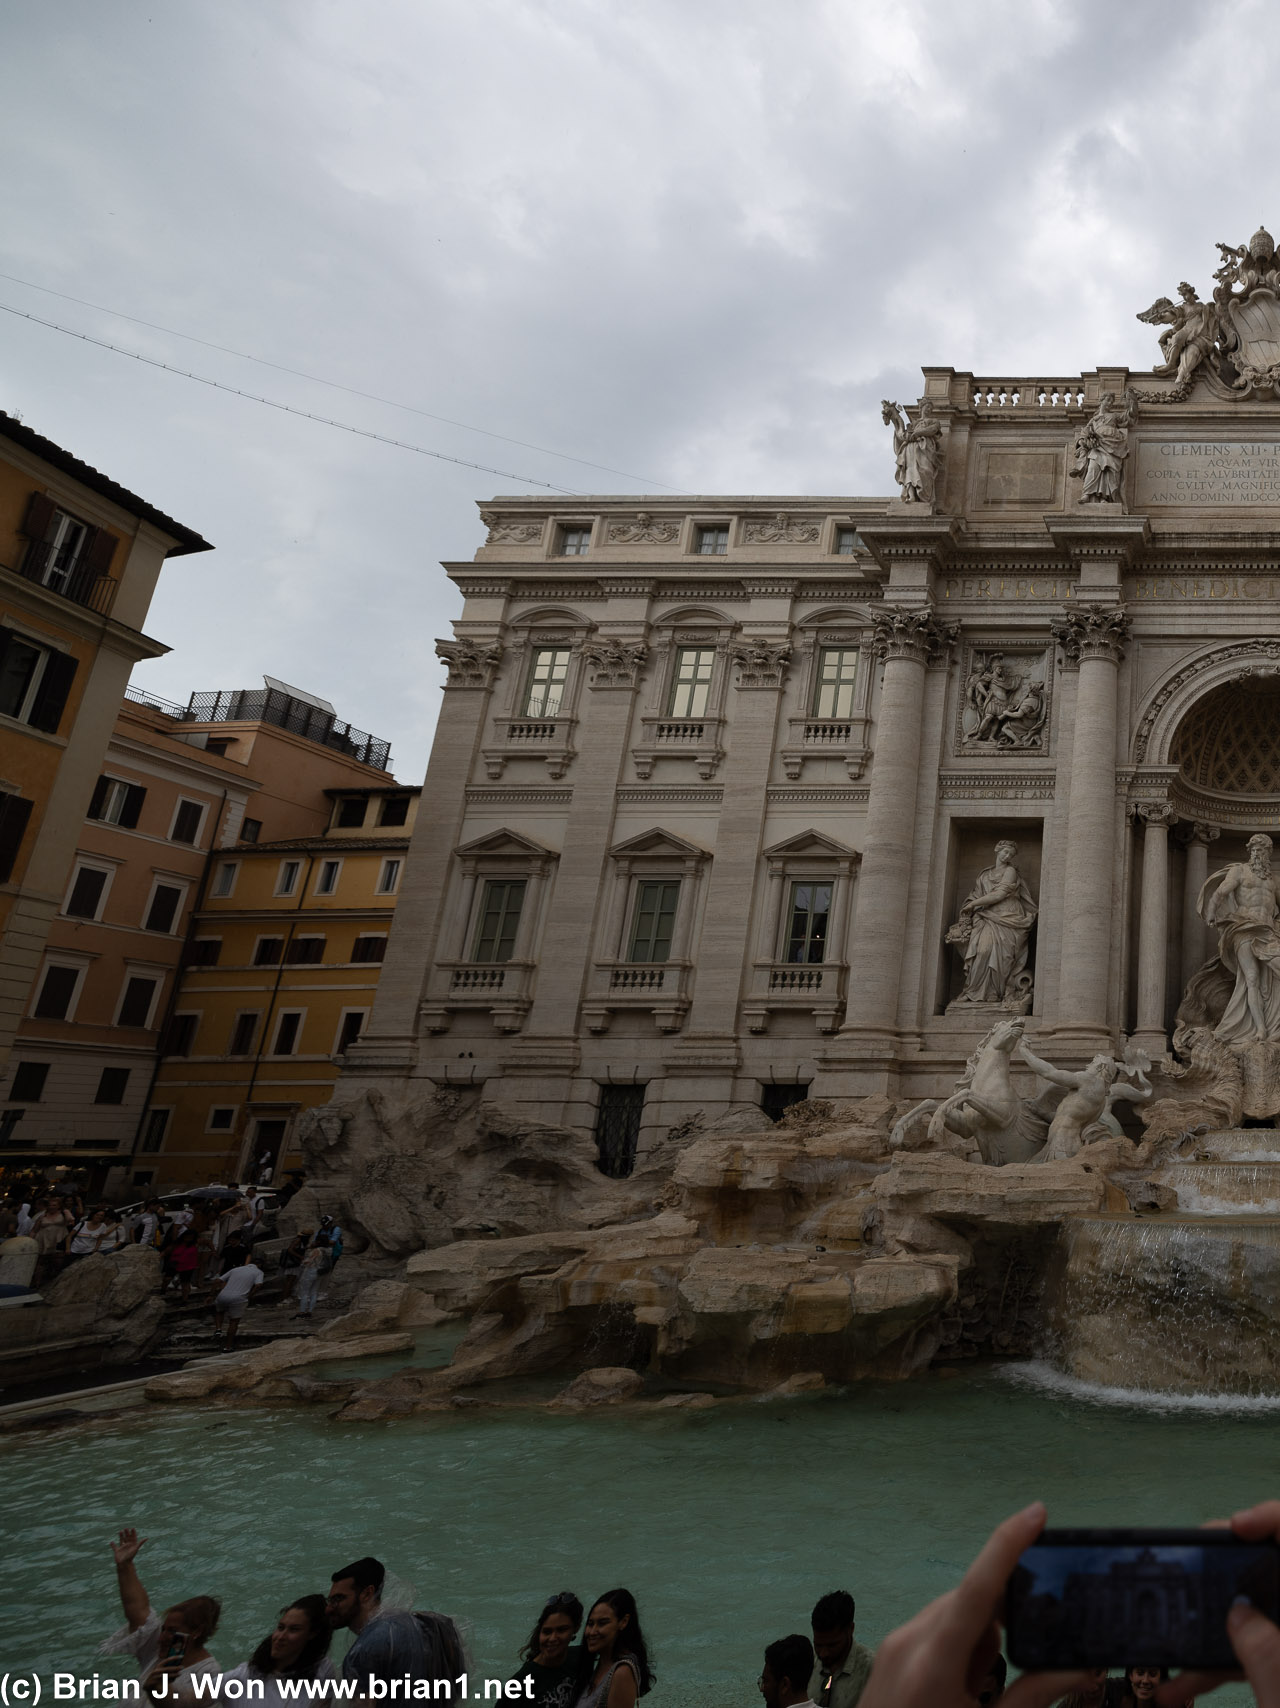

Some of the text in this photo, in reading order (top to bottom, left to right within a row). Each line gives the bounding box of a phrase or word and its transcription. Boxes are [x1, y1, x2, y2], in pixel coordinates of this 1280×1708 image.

[1160, 445, 1231, 456] CLEMENS
[1206, 458, 1252, 470] AQVAM
[1146, 470, 1182, 479] COPIA
[1186, 470, 1200, 479] ET
[1204, 469, 1280, 479] SALVBRITATE
[1176, 482, 1216, 490] CVLTV
[1151, 493, 1187, 502] ANNO
[1190, 493, 1235, 502] DOMINI
[945, 579, 1079, 598] PERFECIT
[941, 790, 1055, 799] POSITIS SIGNIS ET ANA
